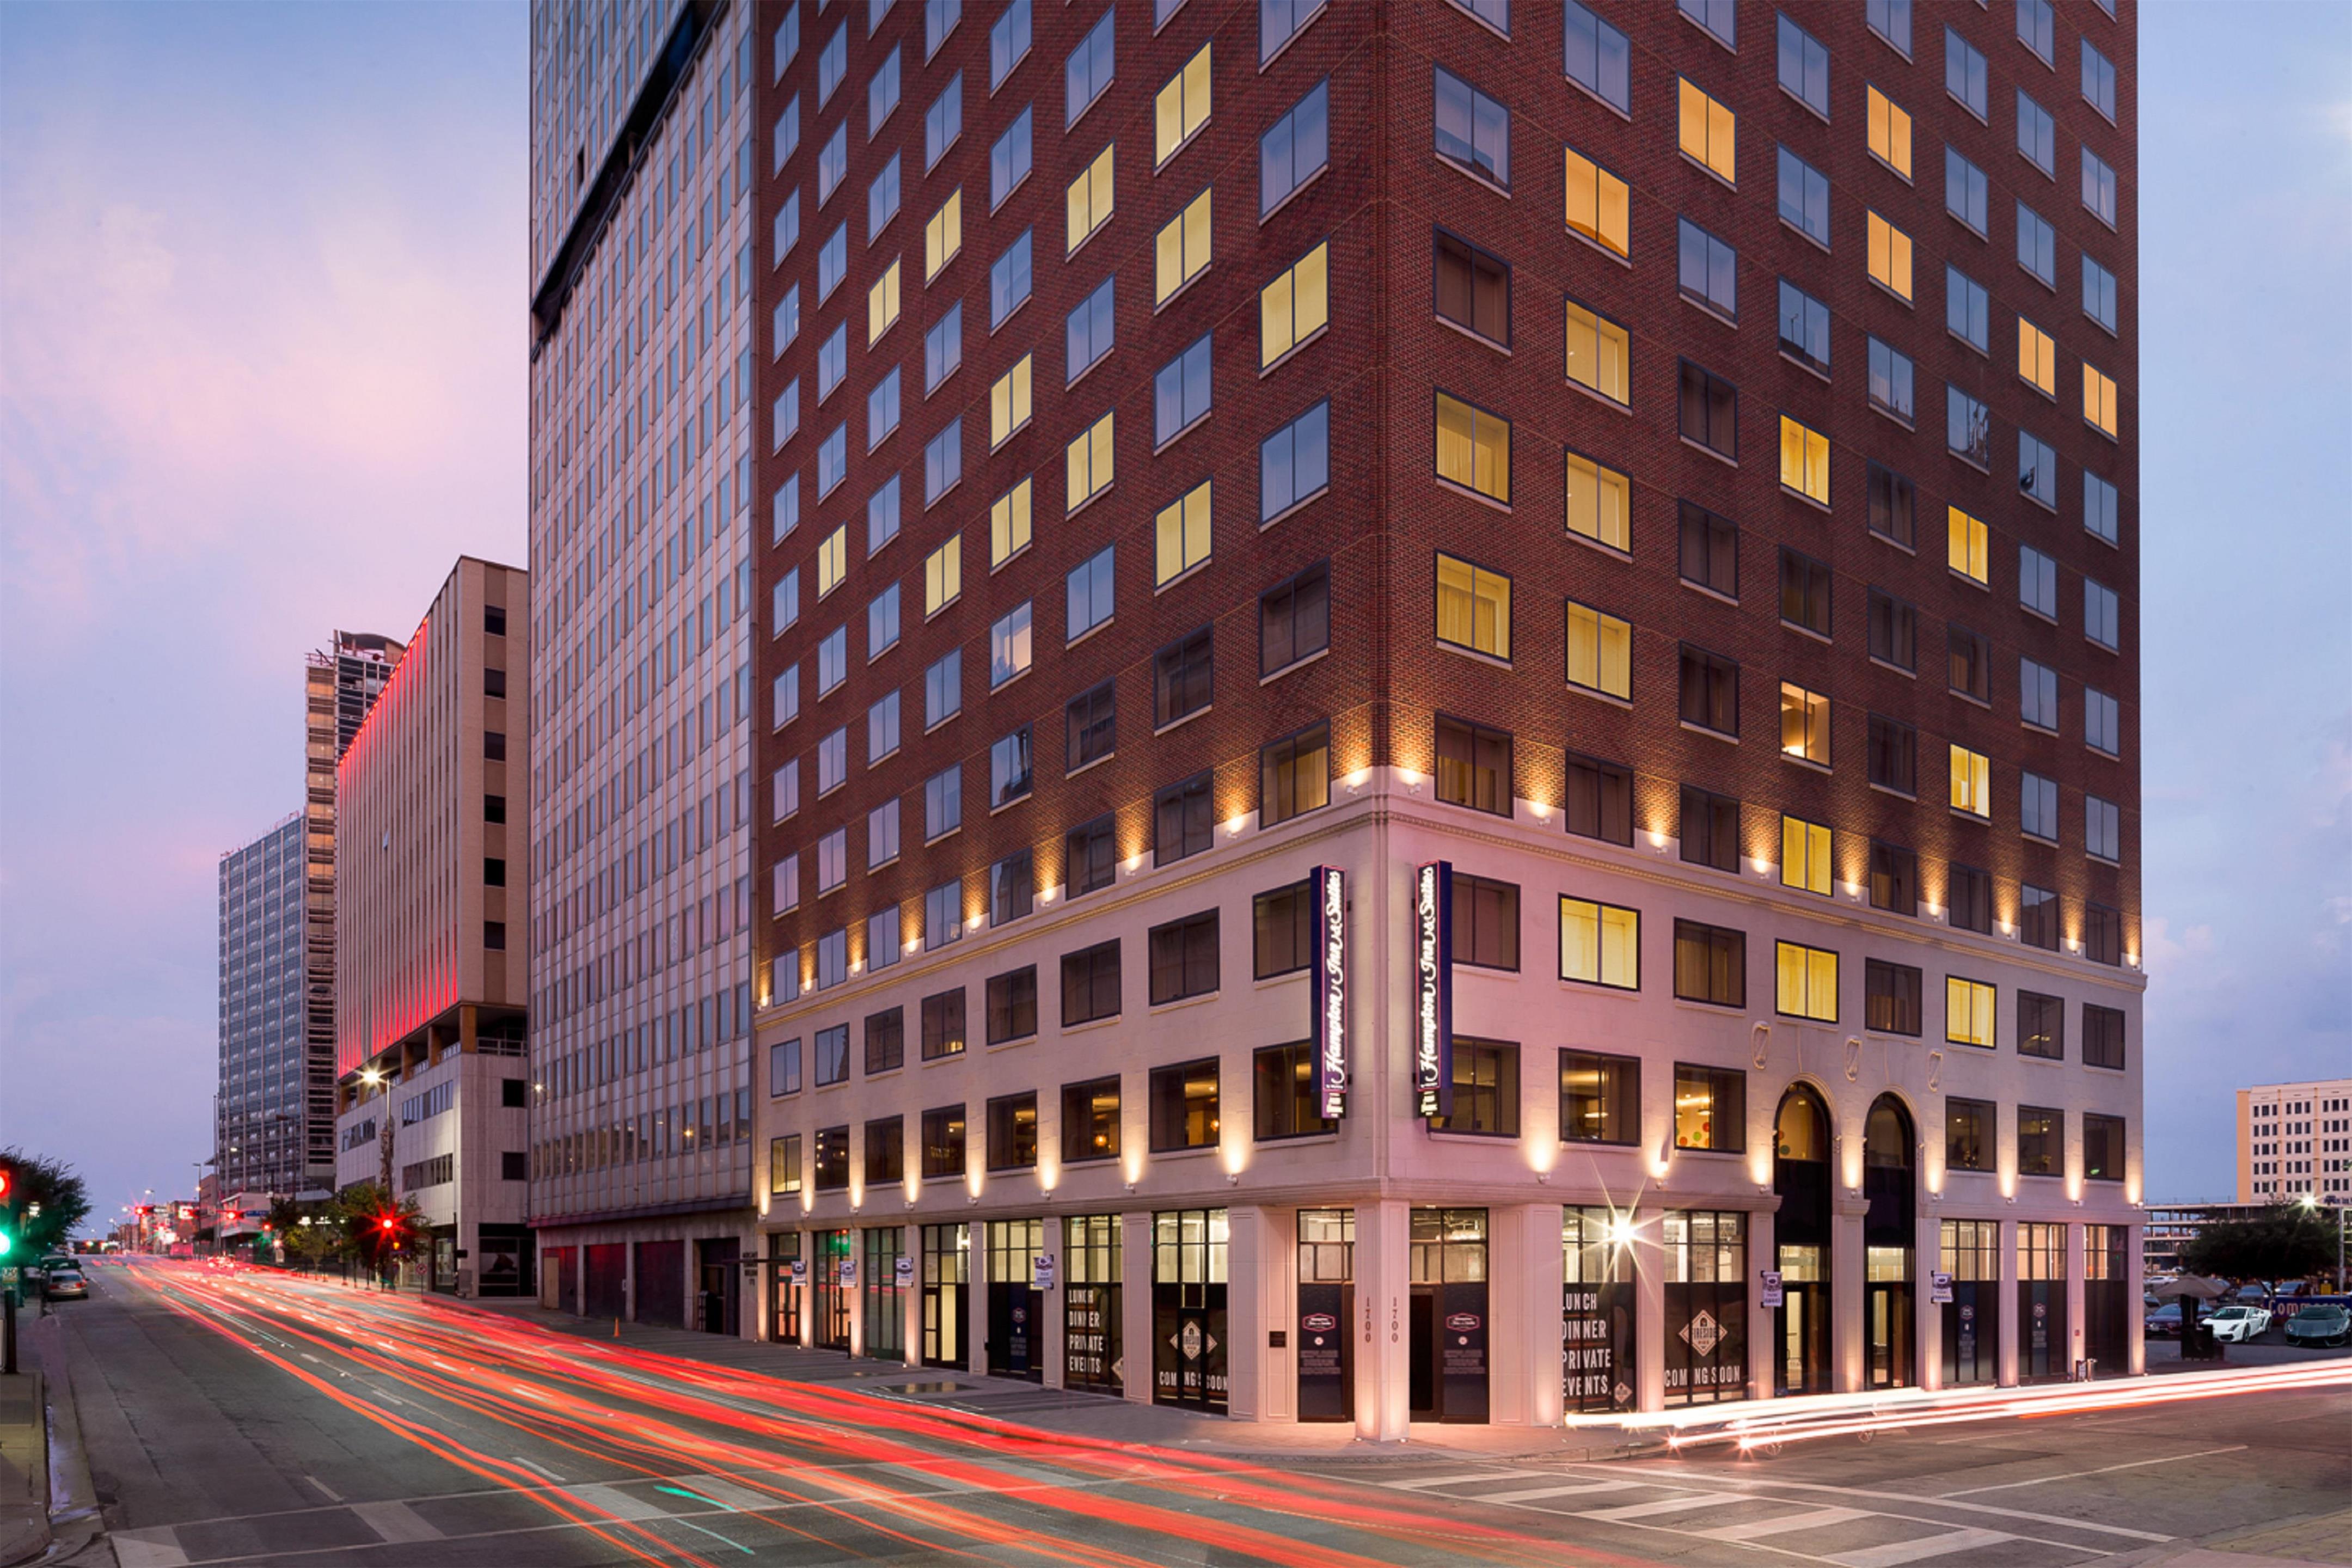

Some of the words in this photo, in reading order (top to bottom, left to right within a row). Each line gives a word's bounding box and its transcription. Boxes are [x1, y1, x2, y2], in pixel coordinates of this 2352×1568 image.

[1326, 871, 1342, 924] Suites
[1419, 866, 1435, 921] Suites
[1326, 935, 1344, 985] Inn
[1420, 930, 1437, 982] Inn
[1325, 986, 1345, 1084] Hampton
[1419, 982, 1438, 1082] Hampton
[1159, 1371, 1196, 1386] COMNG
[1664, 1367, 1708, 1387] COMNG
[1711, 1365, 1741, 1384] SOON
